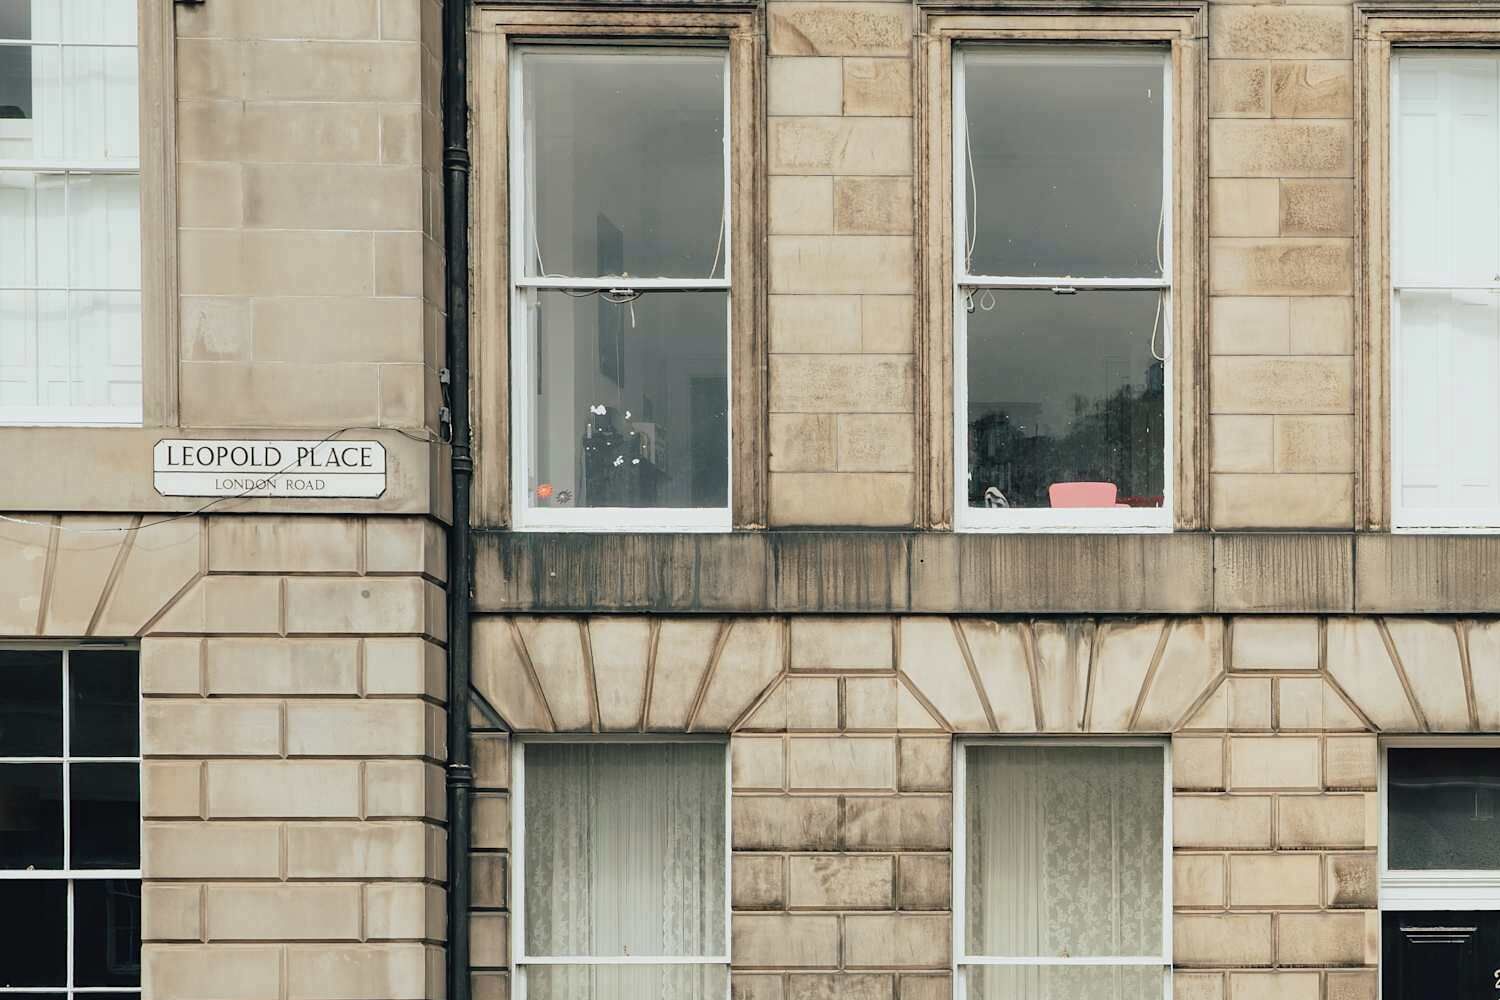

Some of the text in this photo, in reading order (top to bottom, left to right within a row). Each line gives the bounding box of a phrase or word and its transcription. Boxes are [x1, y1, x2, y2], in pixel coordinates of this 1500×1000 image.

[167, 446, 373, 467] LEOPOLD PLACE
[215, 479, 325, 490] LONDON ROAD
